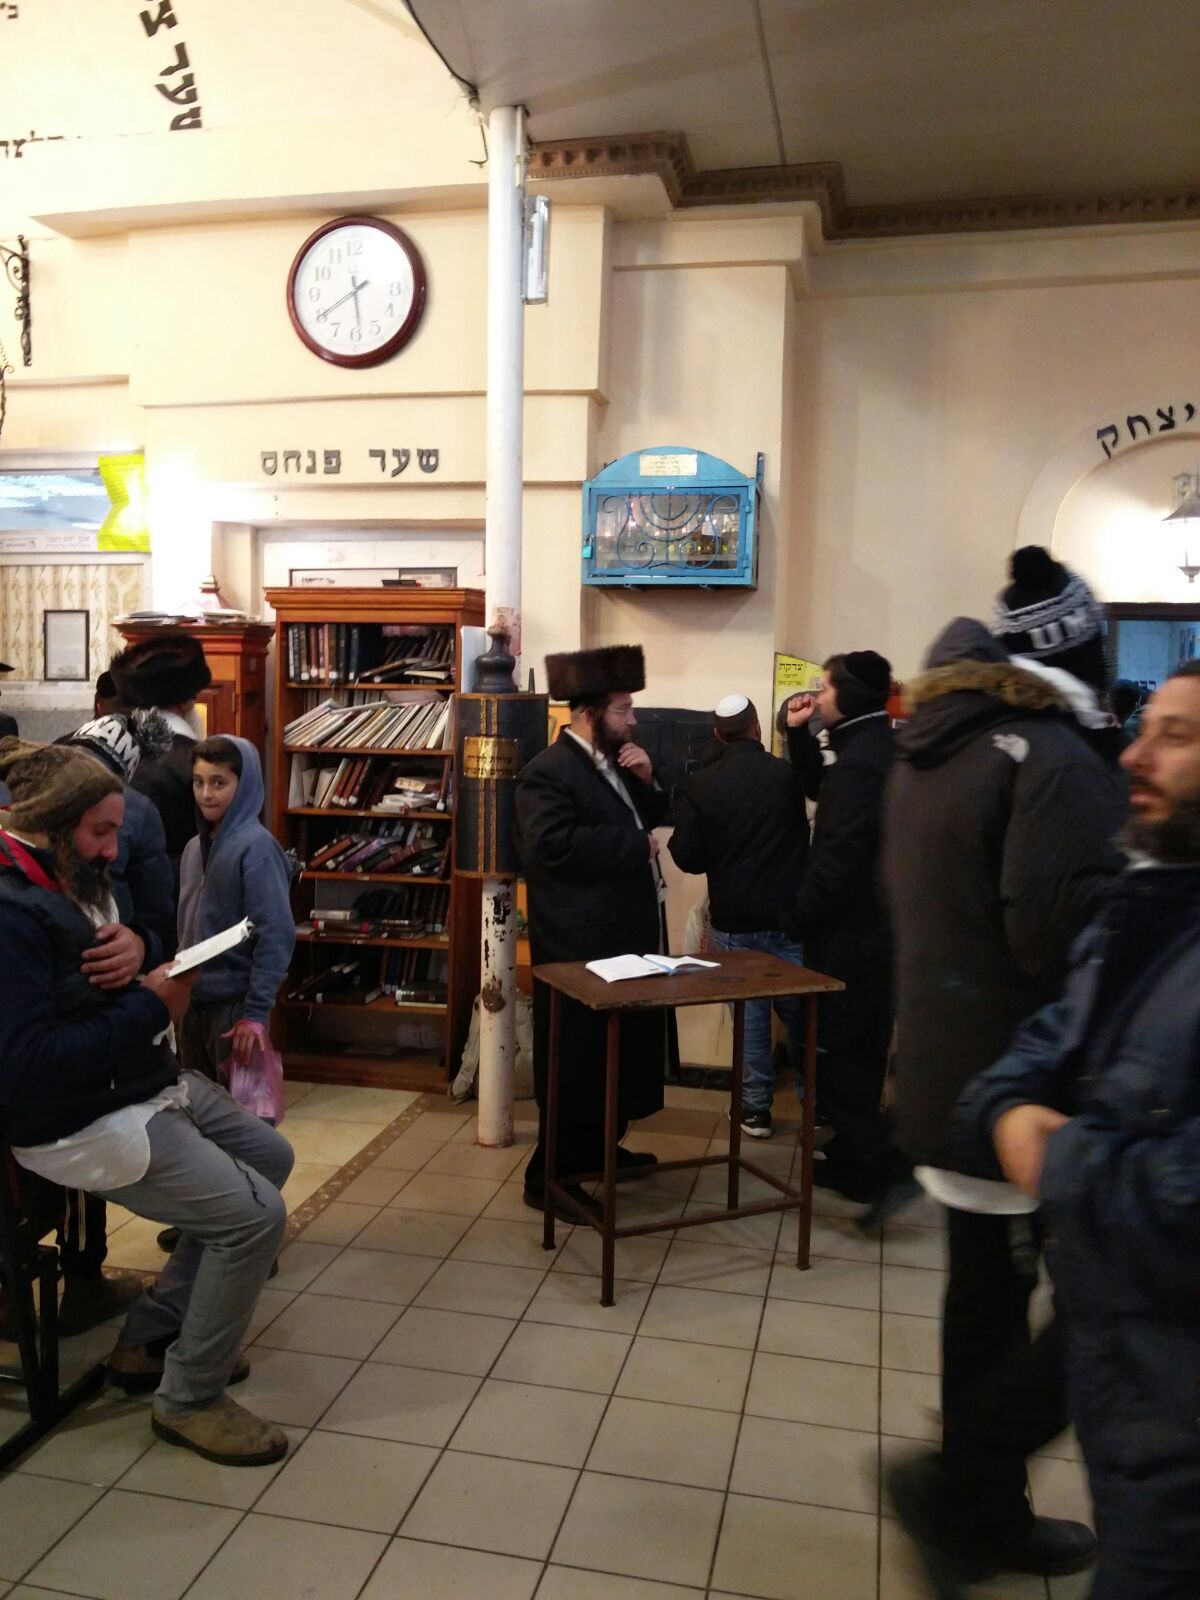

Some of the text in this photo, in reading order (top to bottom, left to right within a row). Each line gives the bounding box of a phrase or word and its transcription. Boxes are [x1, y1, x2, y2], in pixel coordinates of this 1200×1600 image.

[329, 248, 342, 264] 11
[346, 239, 364, 256] 12
[314, 265, 332, 282] 10
[308, 286, 320, 302] 9
[388, 280, 402, 297] 3
[330, 321, 341, 338] 7
[349, 327, 362, 343] 6
[368, 319, 382, 336] 5
[1096, 402, 1195, 459] יצחק
[260, 448, 439, 478] שער פנחס
